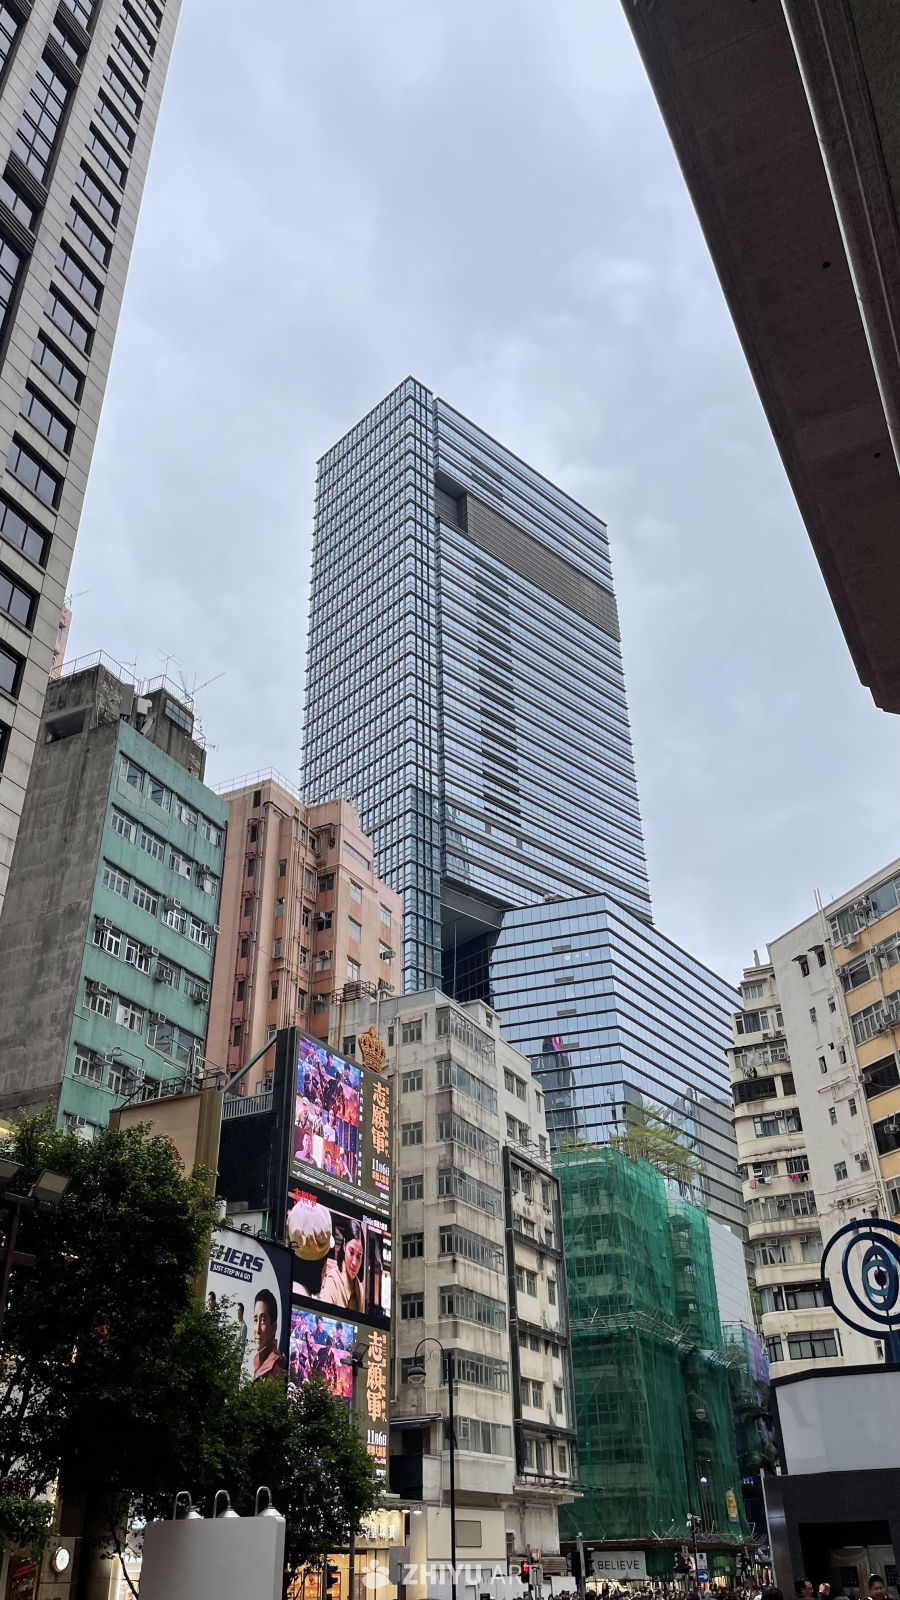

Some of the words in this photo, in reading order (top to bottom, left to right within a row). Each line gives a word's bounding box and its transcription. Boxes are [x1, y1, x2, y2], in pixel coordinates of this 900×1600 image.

[372, 1081, 387, 1155] 志願軍
[372, 1158, 390, 1177] 11月6日
[212, 1264, 223, 1272] JUST
[224, 1267, 234, 1275] STEP
[367, 1331, 382, 1422] 志願軍
[366, 1429, 386, 1445] 11月6日
[598, 1560, 640, 1570] BELIEVE
